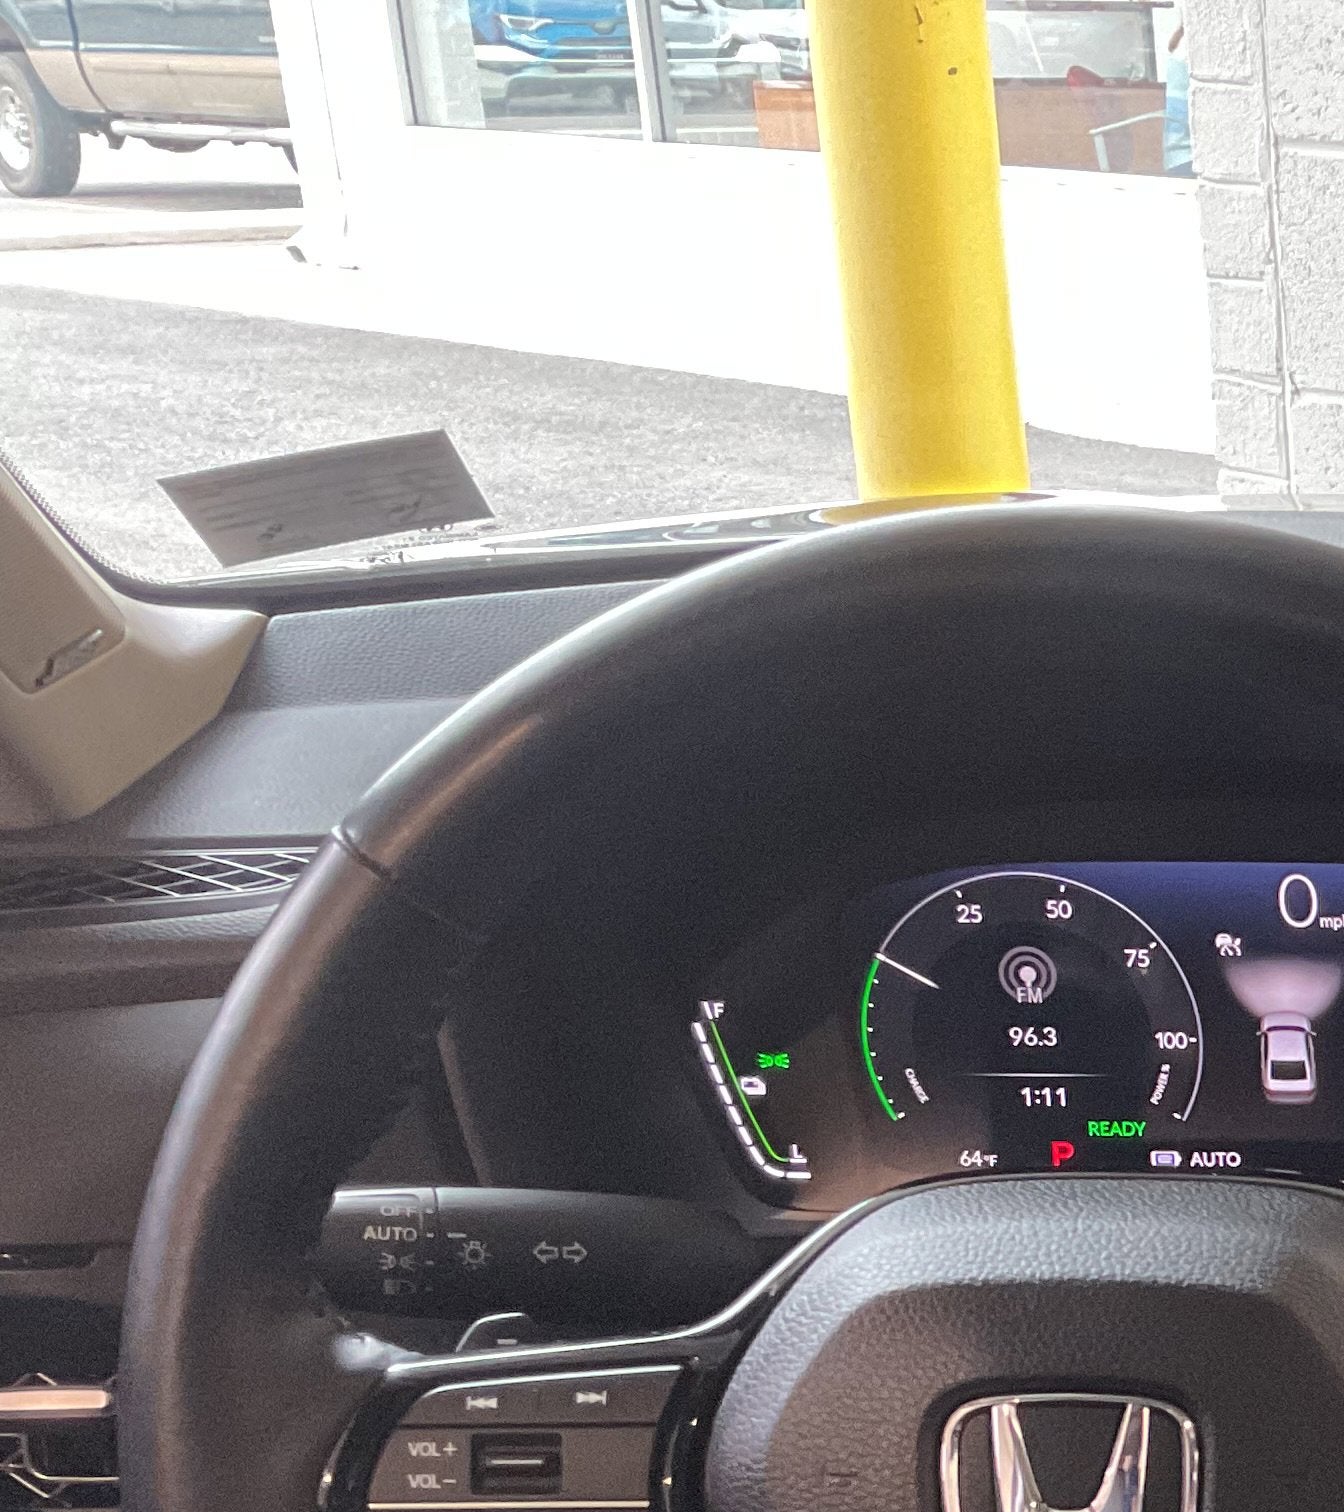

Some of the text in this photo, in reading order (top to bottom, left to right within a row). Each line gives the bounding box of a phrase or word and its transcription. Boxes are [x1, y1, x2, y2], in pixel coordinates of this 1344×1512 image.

[1046, 899, 1072, 919] 50
[1277, 873, 1318, 928] 0
[956, 904, 983, 923] 25
[1123, 949, 1150, 968] 75
[1016, 986, 1043, 1004] FM
[1008, 1027, 1058, 1047] 96.3
[1155, 1031, 1188, 1050] 100
[1020, 1086, 1067, 1107] 1:11
[1087, 1120, 1147, 1137] READY
[1051, 1140, 1075, 1168] P
[1189, 1150, 1242, 1169] AUTO
[362, 1225, 418, 1242] AUTO
